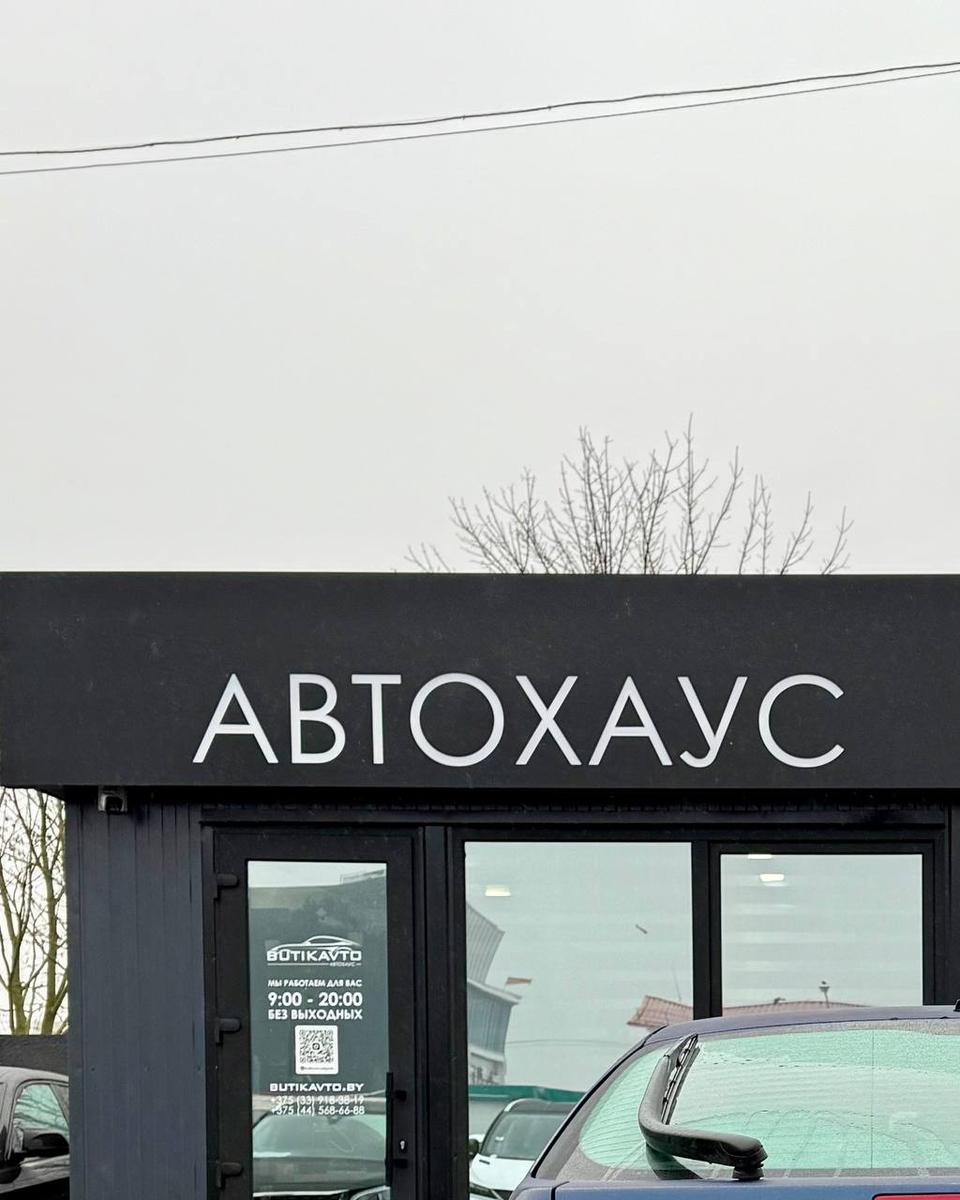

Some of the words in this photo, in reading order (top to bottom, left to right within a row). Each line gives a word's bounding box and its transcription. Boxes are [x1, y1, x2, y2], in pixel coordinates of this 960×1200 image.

[192, 672, 845, 769] АВТОХАУС
[266, 950, 362, 961] BUTIKAVTO
[268, 992, 303, 1006] 9:00
[318, 992, 363, 1006] 20:00
[268, 1009, 288, 1020] БЕЗ
[291, 1009, 363, 1020] ВЫХОДНЫХ
[269, 1083, 364, 1092] BUTIKAVTO.BY
[296, 1095, 315, 1106] (33)
[296, 1105, 315, 1116] (44)
[318, 1105, 365, 1115] 568-66-88
